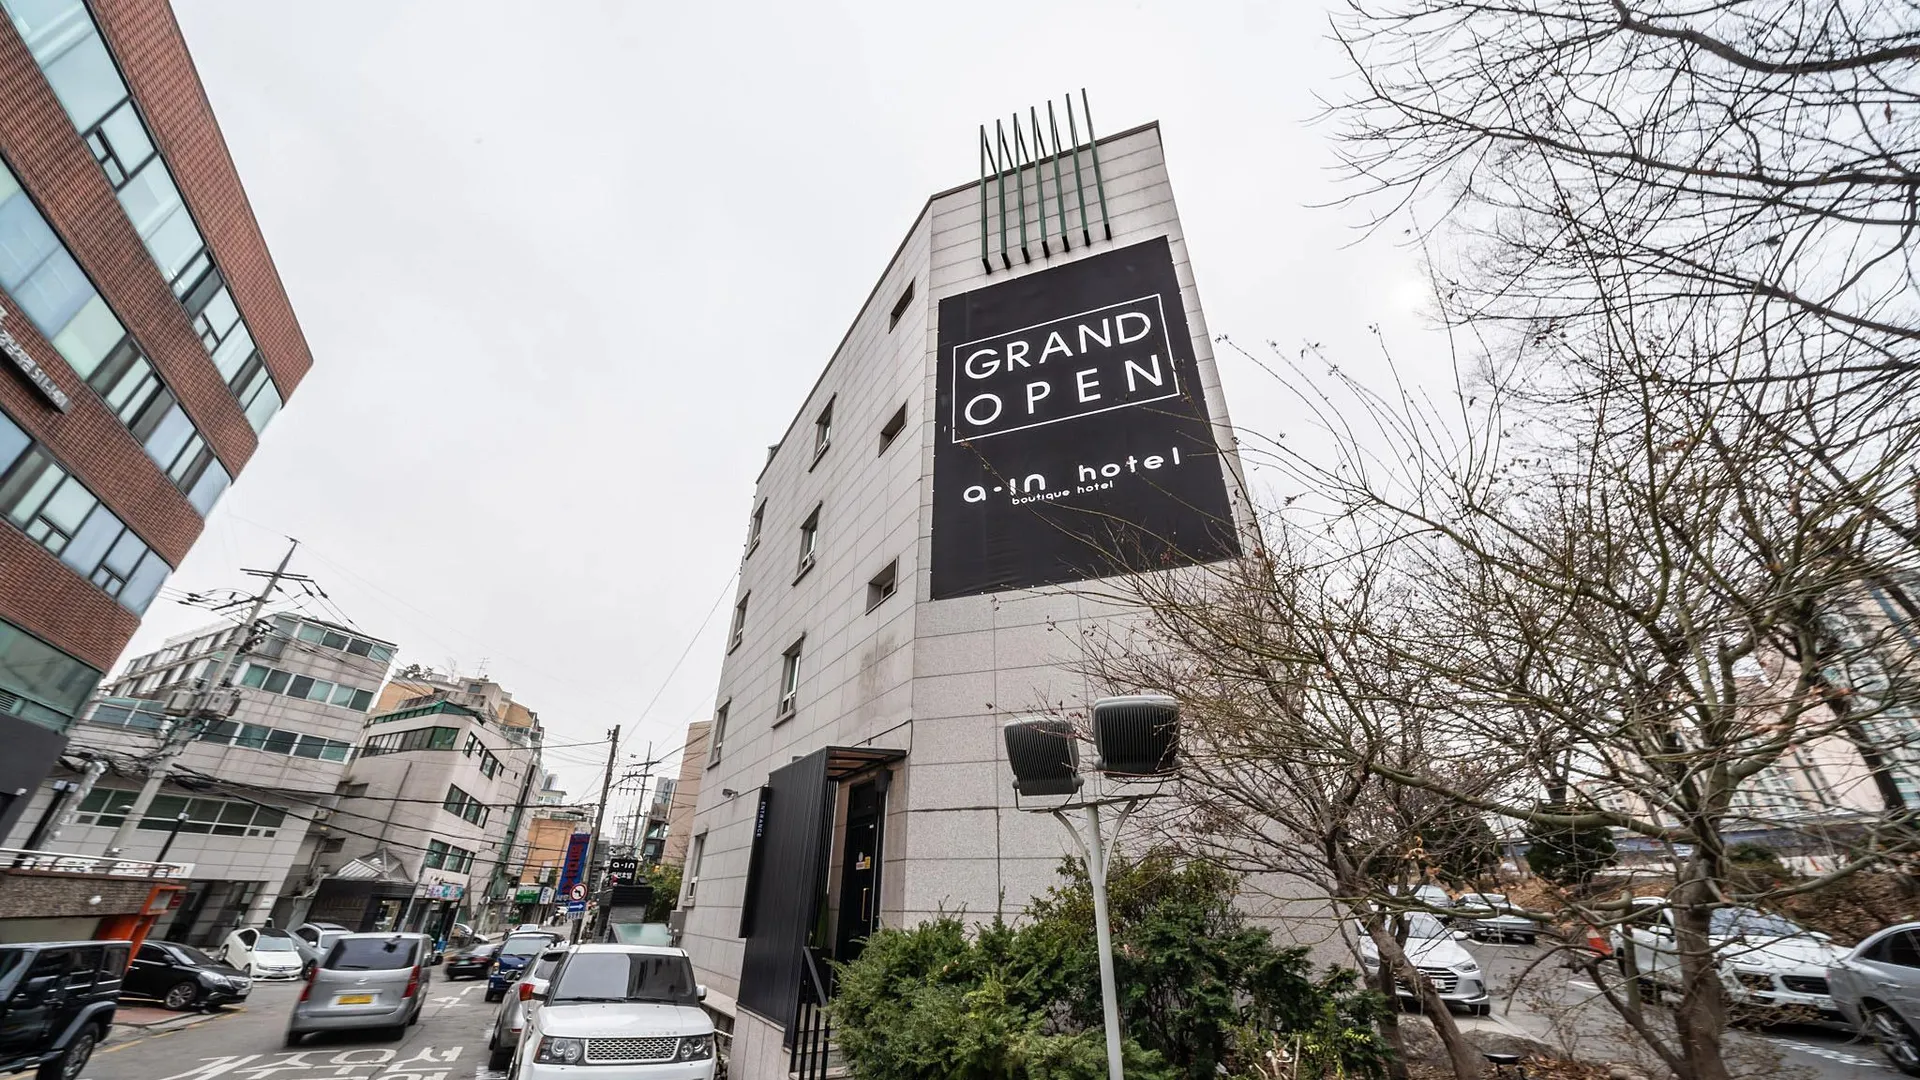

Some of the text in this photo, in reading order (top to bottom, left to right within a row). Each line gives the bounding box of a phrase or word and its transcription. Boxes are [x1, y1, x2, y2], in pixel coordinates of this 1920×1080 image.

[964, 311, 1152, 380] GRAND
[963, 354, 1164, 426] OPEN
[1078, 446, 1181, 483] hotel
[1011, 480, 1114, 505] boutique hotel
[756, 801, 767, 838] ENTRANCE
